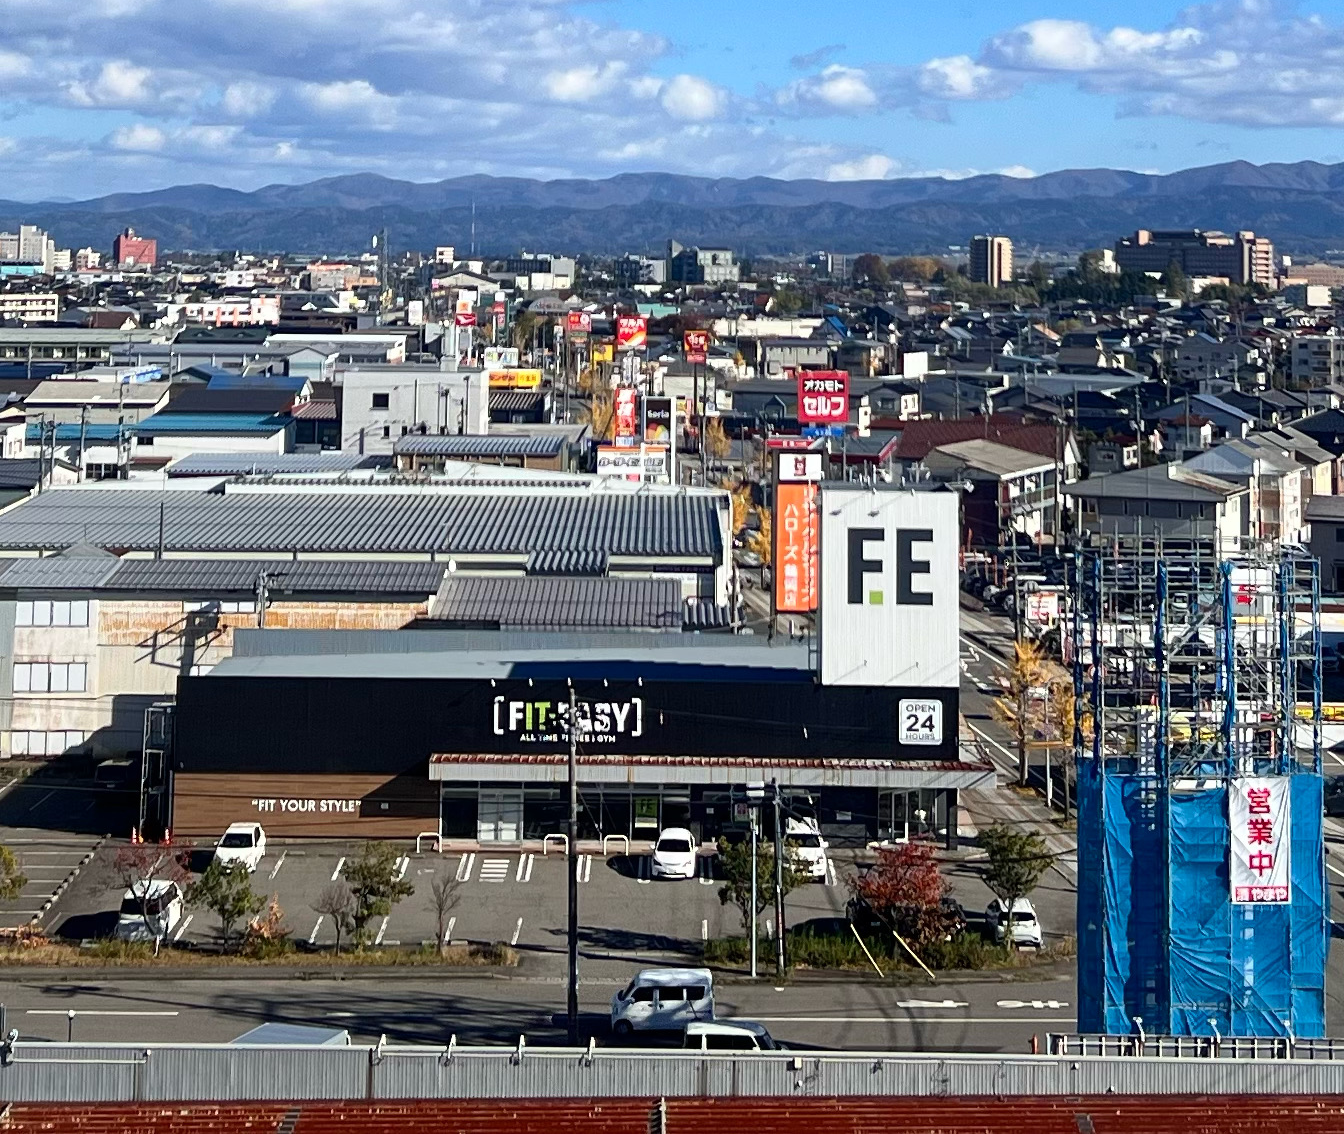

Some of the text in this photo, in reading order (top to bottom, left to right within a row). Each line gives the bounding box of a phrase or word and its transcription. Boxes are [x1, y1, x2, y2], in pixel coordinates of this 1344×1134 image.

[804, 379, 844, 392] オカモト
[803, 395, 845, 416] セルフ
[905, 703, 936, 713] OPEN
[906, 714, 936, 733] 24
[905, 732, 936, 741] HOURS
[279, 799, 316, 812] YOUR
[1247, 787, 1273, 877] 営業中
